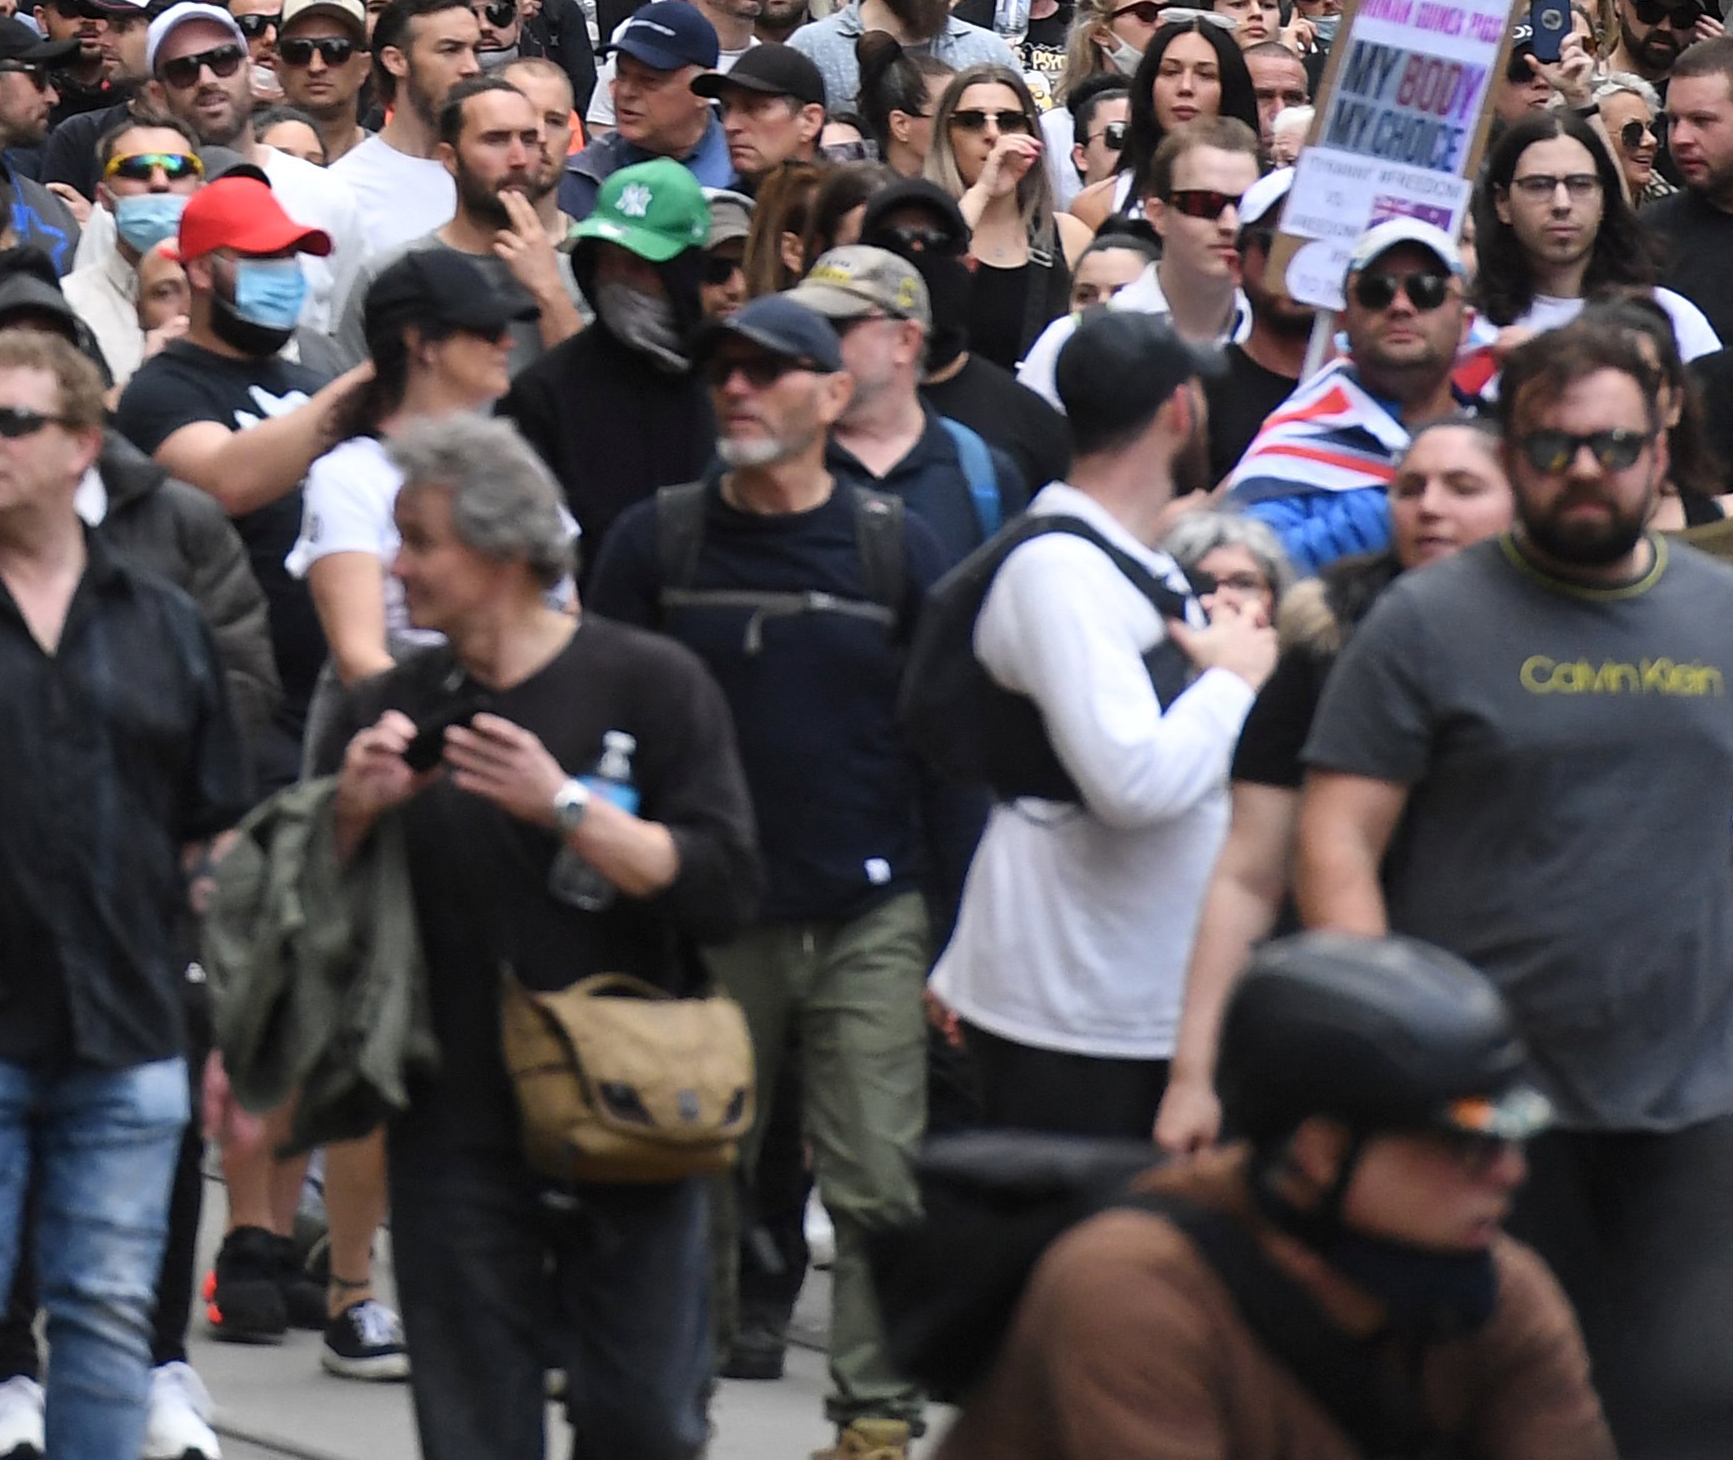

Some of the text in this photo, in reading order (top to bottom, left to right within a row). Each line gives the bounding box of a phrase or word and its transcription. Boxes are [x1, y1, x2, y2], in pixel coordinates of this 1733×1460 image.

[1341, 39, 1487, 120] MY BODY
[1326, 97, 1465, 173] MY CHOICE
[1519, 654, 1725, 698] Calvin Klein
